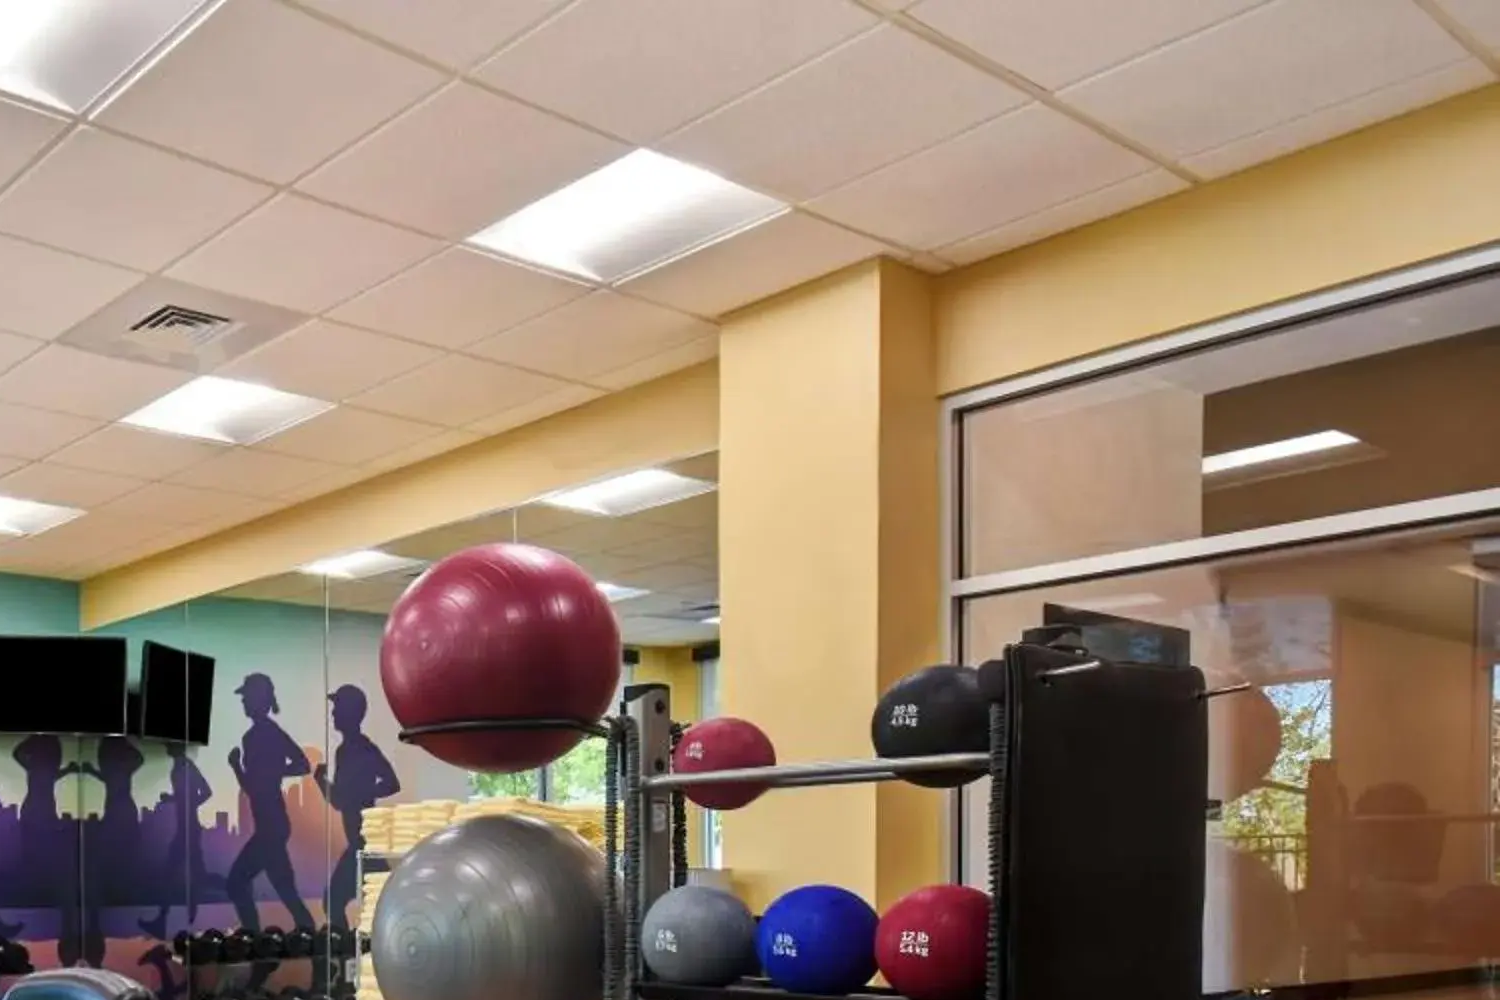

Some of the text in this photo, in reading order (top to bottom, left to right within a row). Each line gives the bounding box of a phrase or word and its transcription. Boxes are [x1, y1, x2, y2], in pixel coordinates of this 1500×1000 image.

[901, 930, 930, 943] 12 lb
[915, 943, 929, 957] kg
